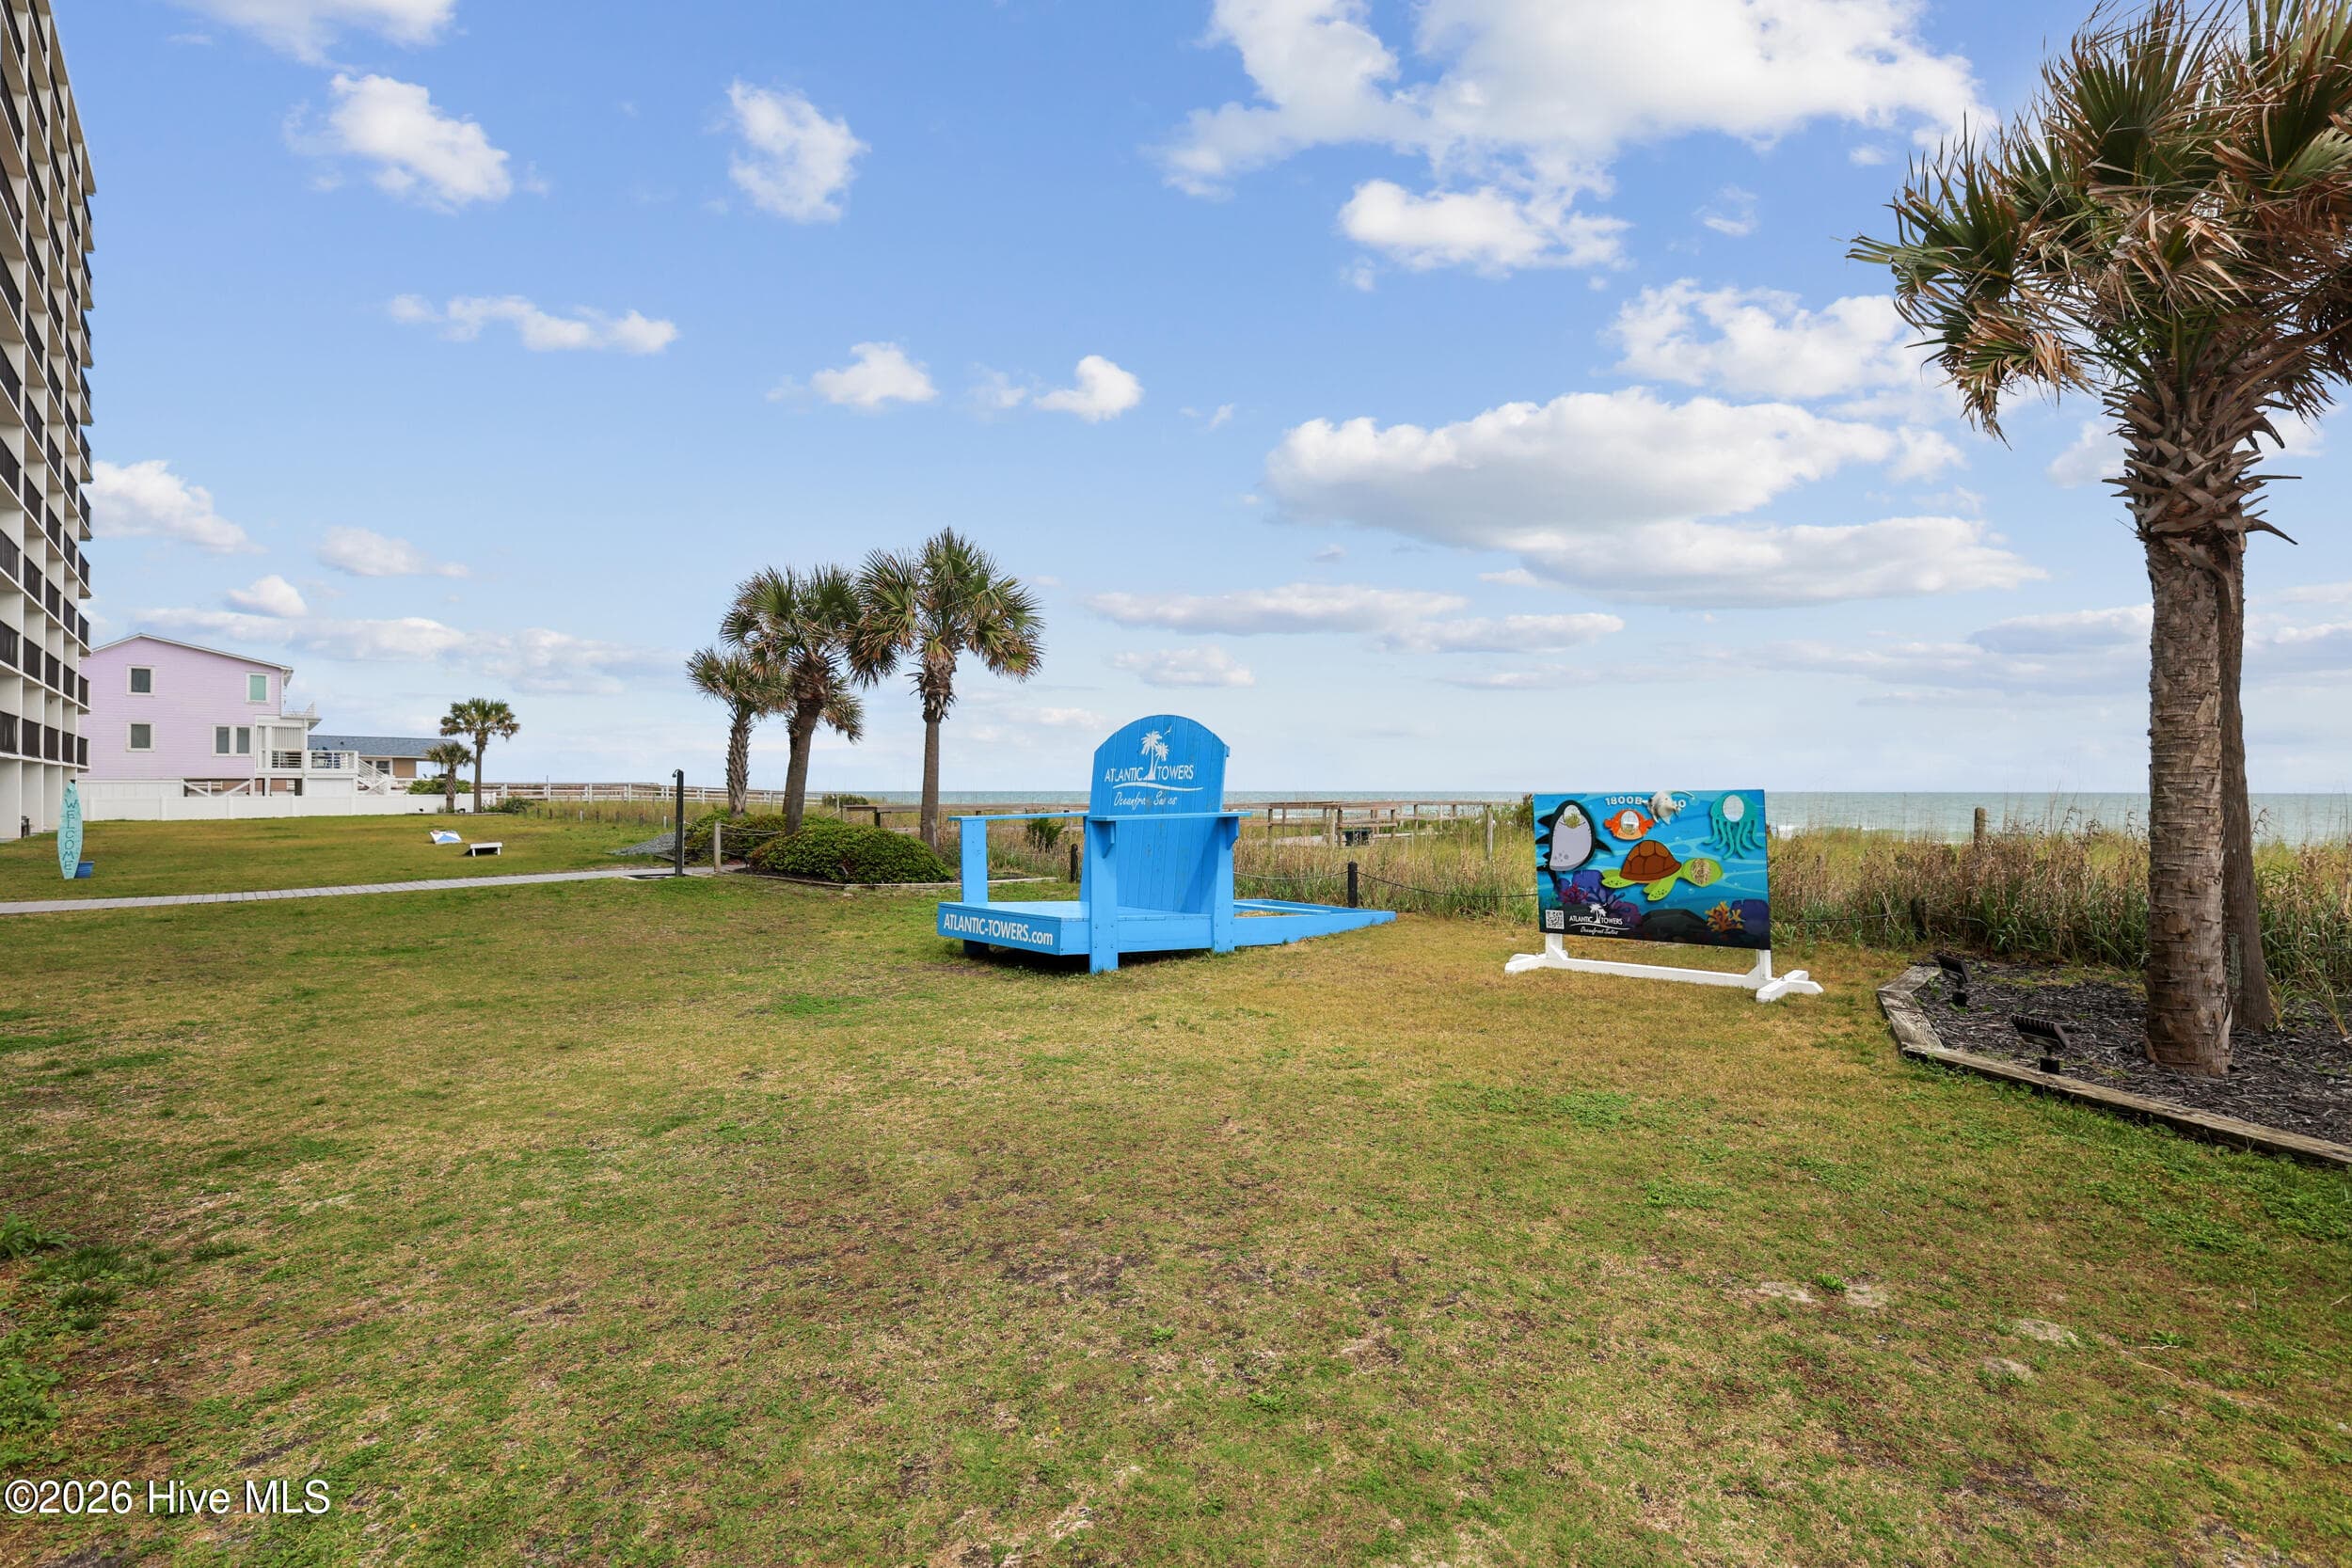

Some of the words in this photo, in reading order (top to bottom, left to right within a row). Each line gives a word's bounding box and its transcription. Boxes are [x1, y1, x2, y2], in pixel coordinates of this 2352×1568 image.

[1157, 765, 1194, 781] TOWERS
[63, 798, 78, 870] WELCOME
[944, 913, 1054, 946] ATLANTIC-TOWERS.com
[1601, 917, 1623, 926] TOWERS
